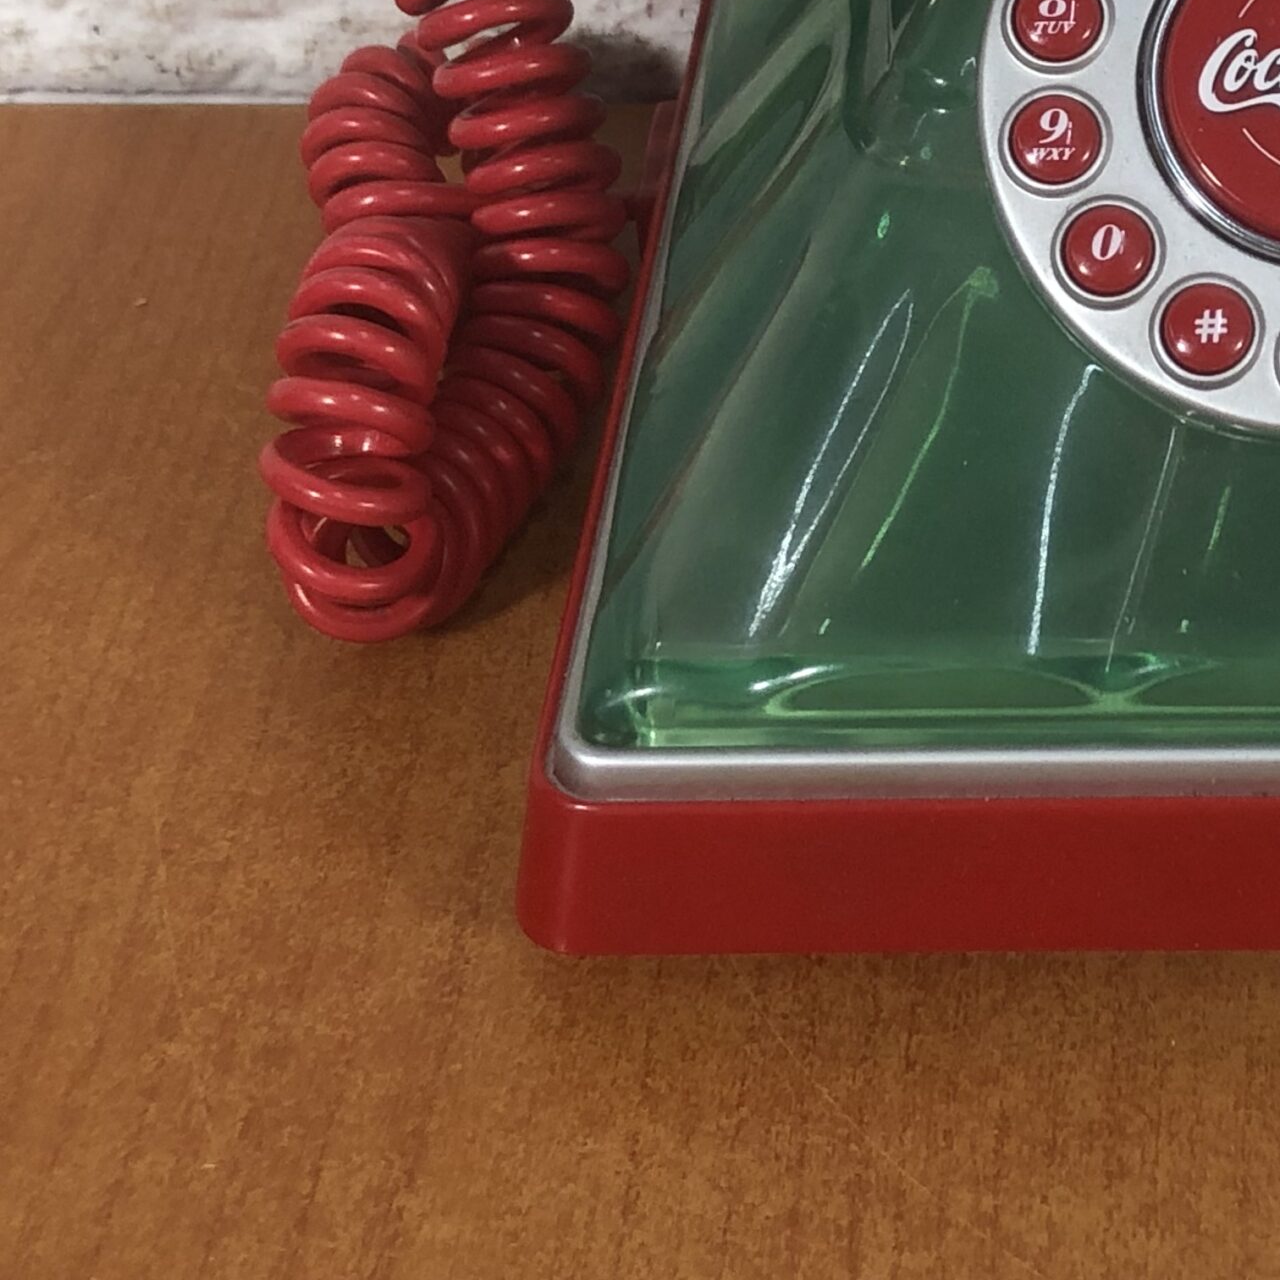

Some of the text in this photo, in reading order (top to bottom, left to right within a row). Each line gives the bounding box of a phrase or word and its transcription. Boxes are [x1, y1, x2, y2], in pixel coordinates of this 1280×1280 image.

[1034, 21, 1075, 34] TUV
[1039, 108, 1069, 144] 9
[1032, 147, 1076, 161] WXY
[1091, 224, 1122, 261] 0
